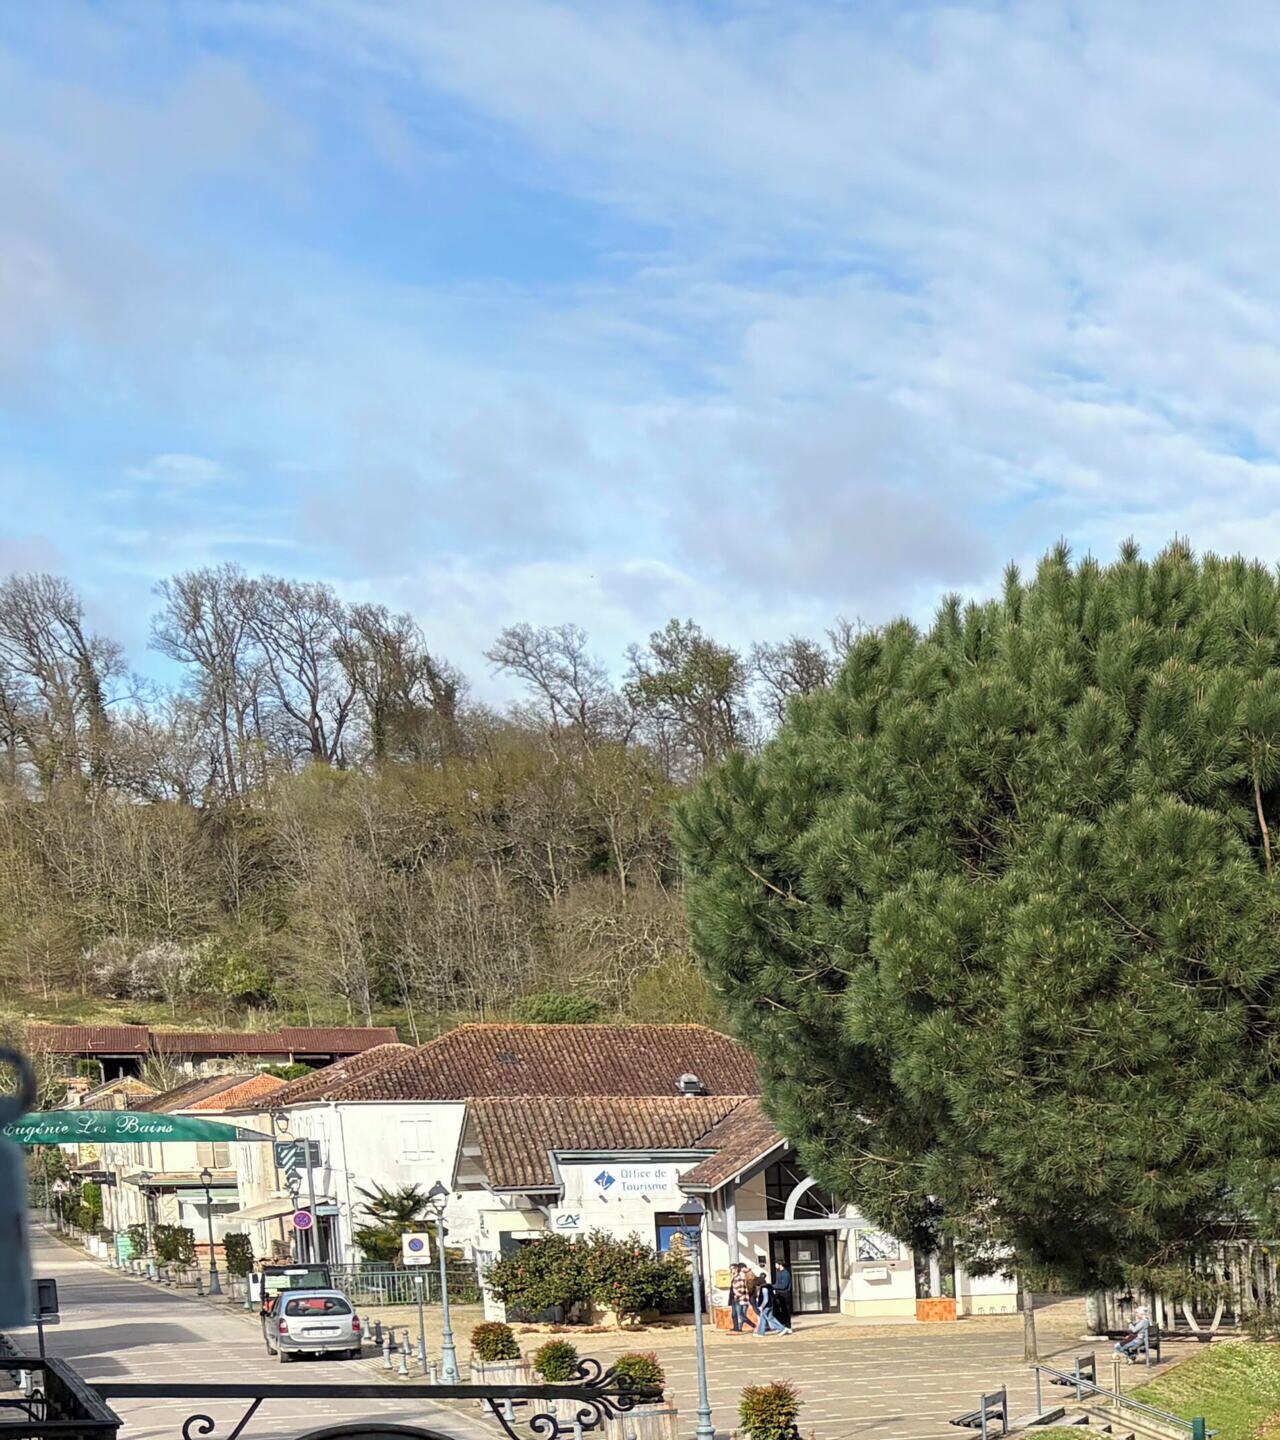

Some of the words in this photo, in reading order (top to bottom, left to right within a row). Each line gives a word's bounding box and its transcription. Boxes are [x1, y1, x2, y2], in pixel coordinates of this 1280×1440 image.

[75, 1115, 107, 1134] Les
[115, 1115, 174, 1134] Bains
[620, 1168, 651, 1179] Office
[654, 1168, 667, 1178] de
[621, 1181, 667, 1191] Tourisme
